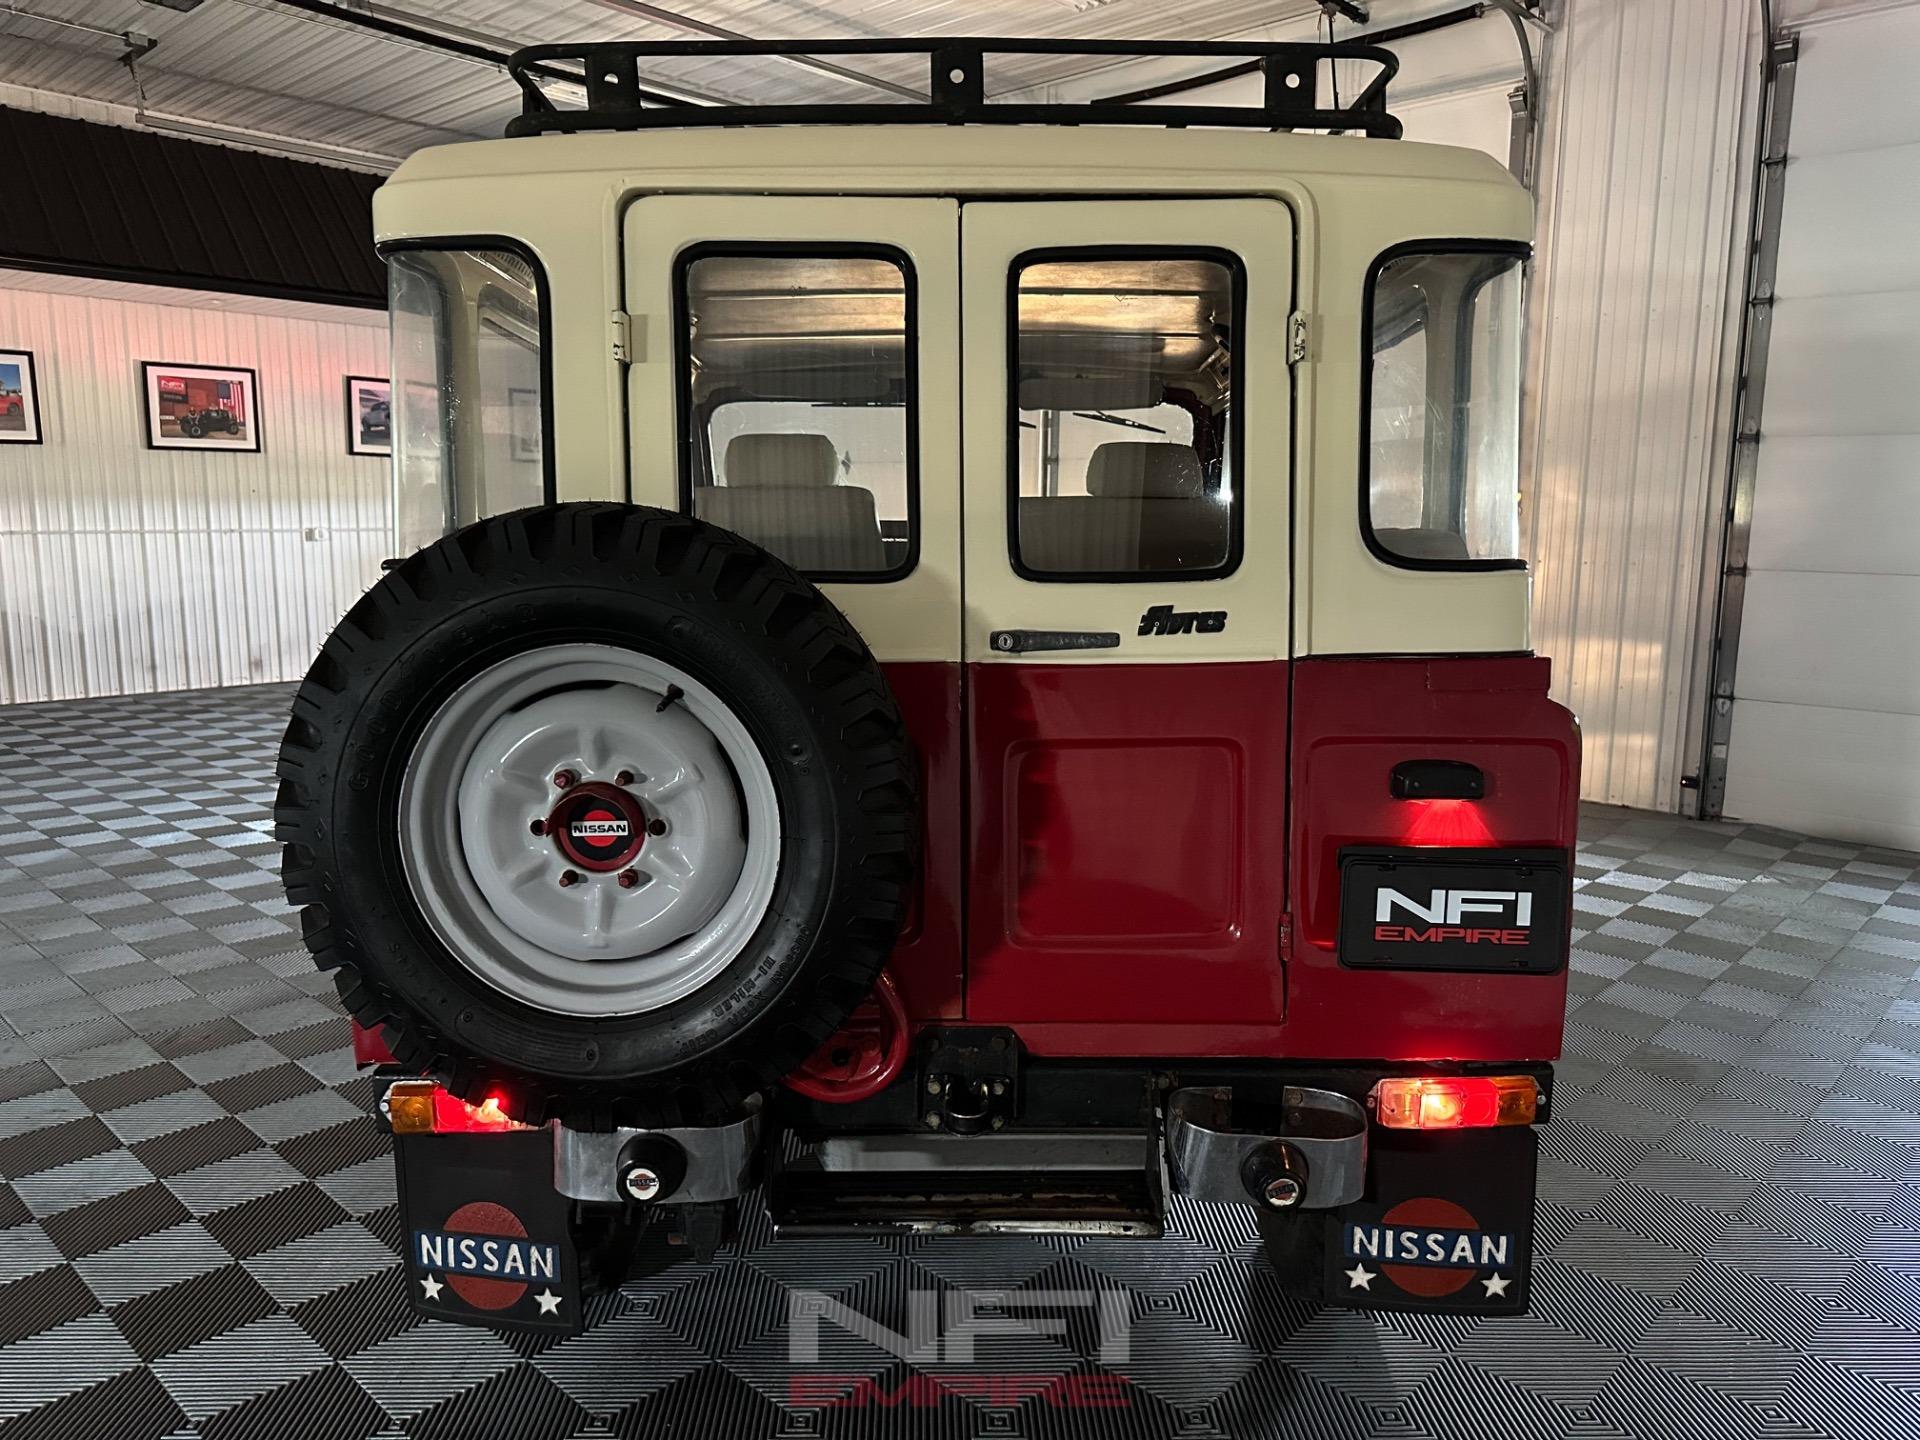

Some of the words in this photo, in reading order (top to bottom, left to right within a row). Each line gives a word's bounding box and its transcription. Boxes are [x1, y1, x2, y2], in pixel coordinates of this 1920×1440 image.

[573, 824, 627, 834] NISSAN
[1375, 887, 1532, 927] NFI
[1375, 926, 1530, 945] EMPIRE
[420, 1234, 553, 1278] NISSAN
[1353, 1226, 1507, 1264] NISSAN
